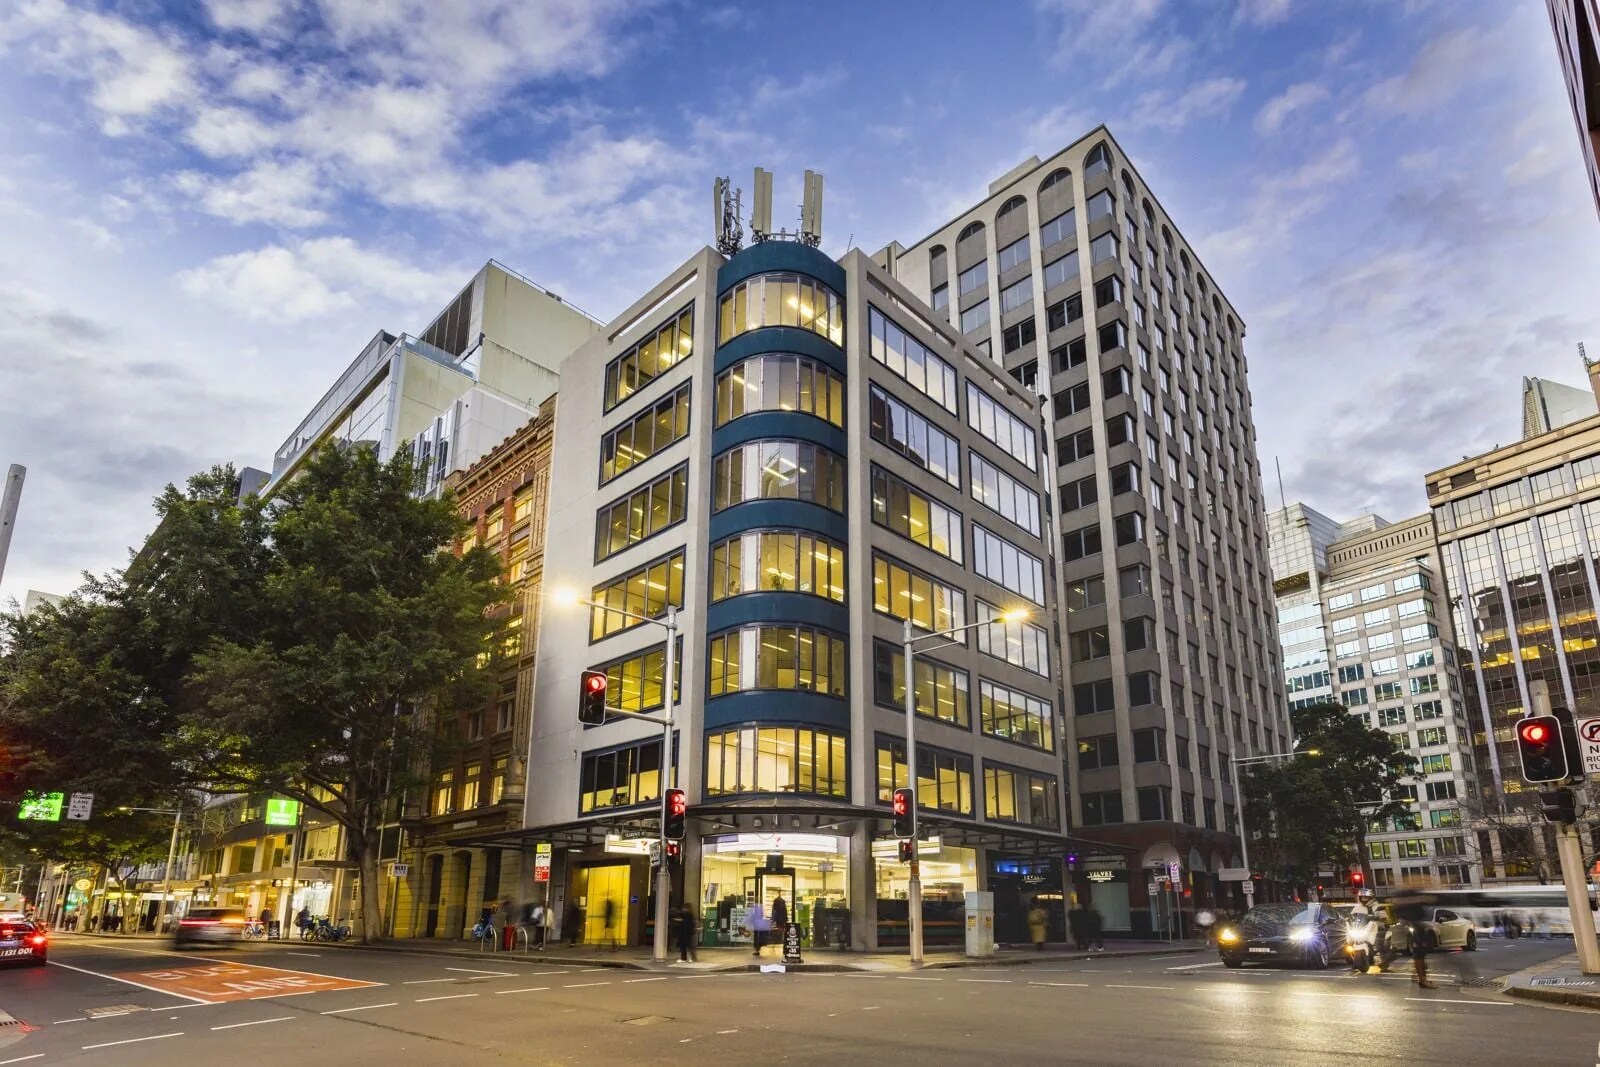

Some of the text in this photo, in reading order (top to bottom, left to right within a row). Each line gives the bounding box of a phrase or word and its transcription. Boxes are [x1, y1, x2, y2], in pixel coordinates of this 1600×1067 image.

[1589, 745, 1600, 753] N
[140, 966, 250, 981] BUS
[182, 976, 339, 996] LANE
